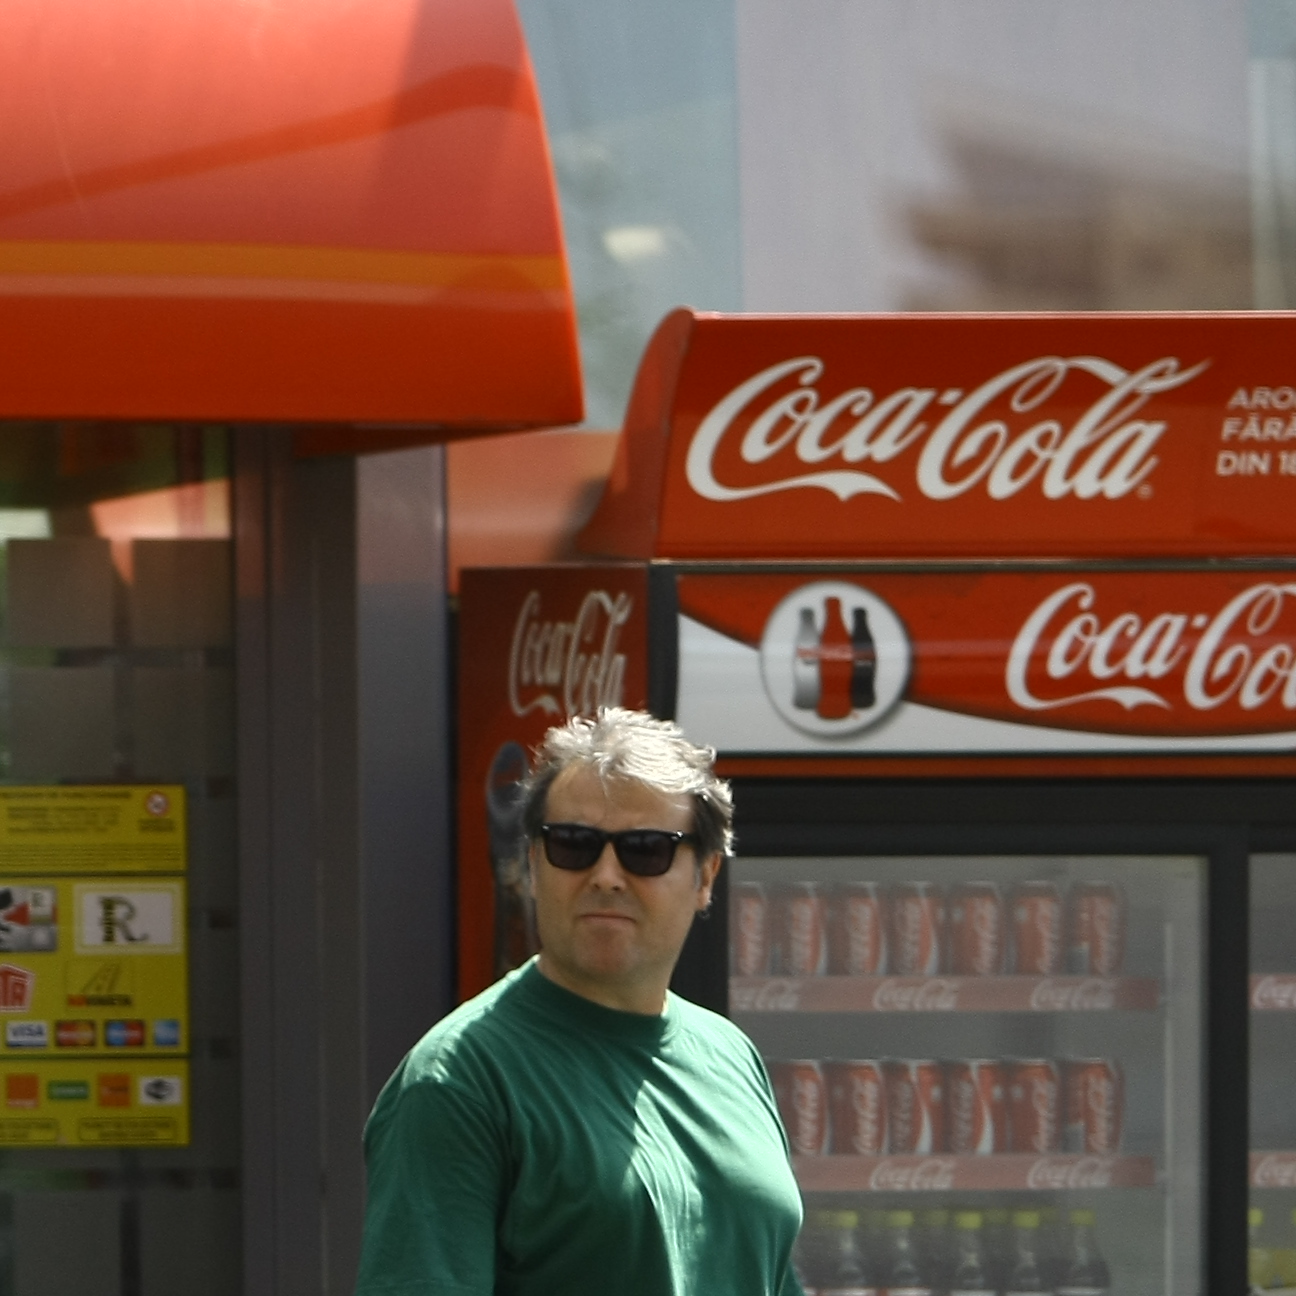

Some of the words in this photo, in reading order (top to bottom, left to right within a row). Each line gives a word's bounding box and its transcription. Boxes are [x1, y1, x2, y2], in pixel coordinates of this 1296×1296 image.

[685, 354, 1212, 502] Coca-Cola
[1216, 450, 1271, 476] DIN
[10, 1024, 45, 1040] VISA
